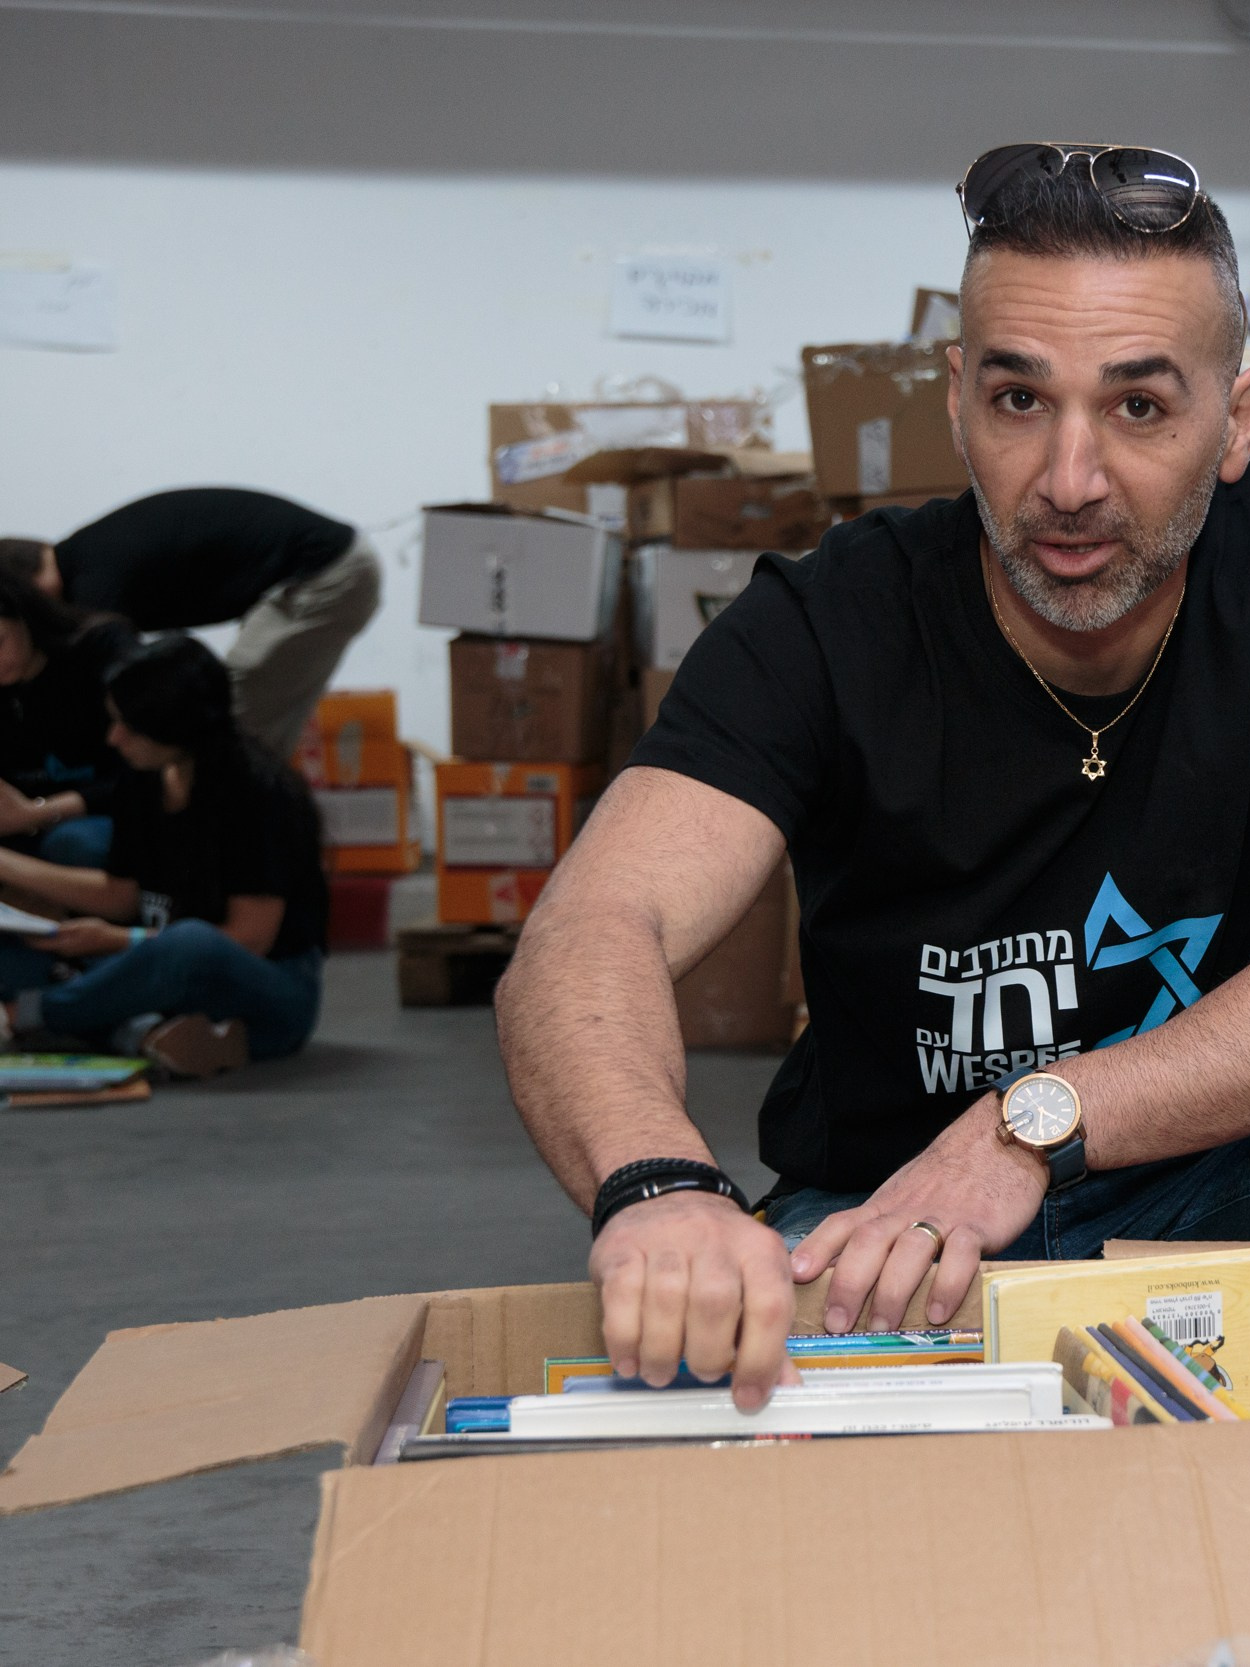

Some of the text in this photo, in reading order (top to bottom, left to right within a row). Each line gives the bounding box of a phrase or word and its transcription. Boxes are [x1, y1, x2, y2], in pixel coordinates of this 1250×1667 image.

[920, 929, 1074, 979] מתנדבים
[918, 964, 1079, 1053] יחד
[916, 1027, 950, 1048] עם
[1148, 1279, 1220, 1292] www.kinbooks.co.il
